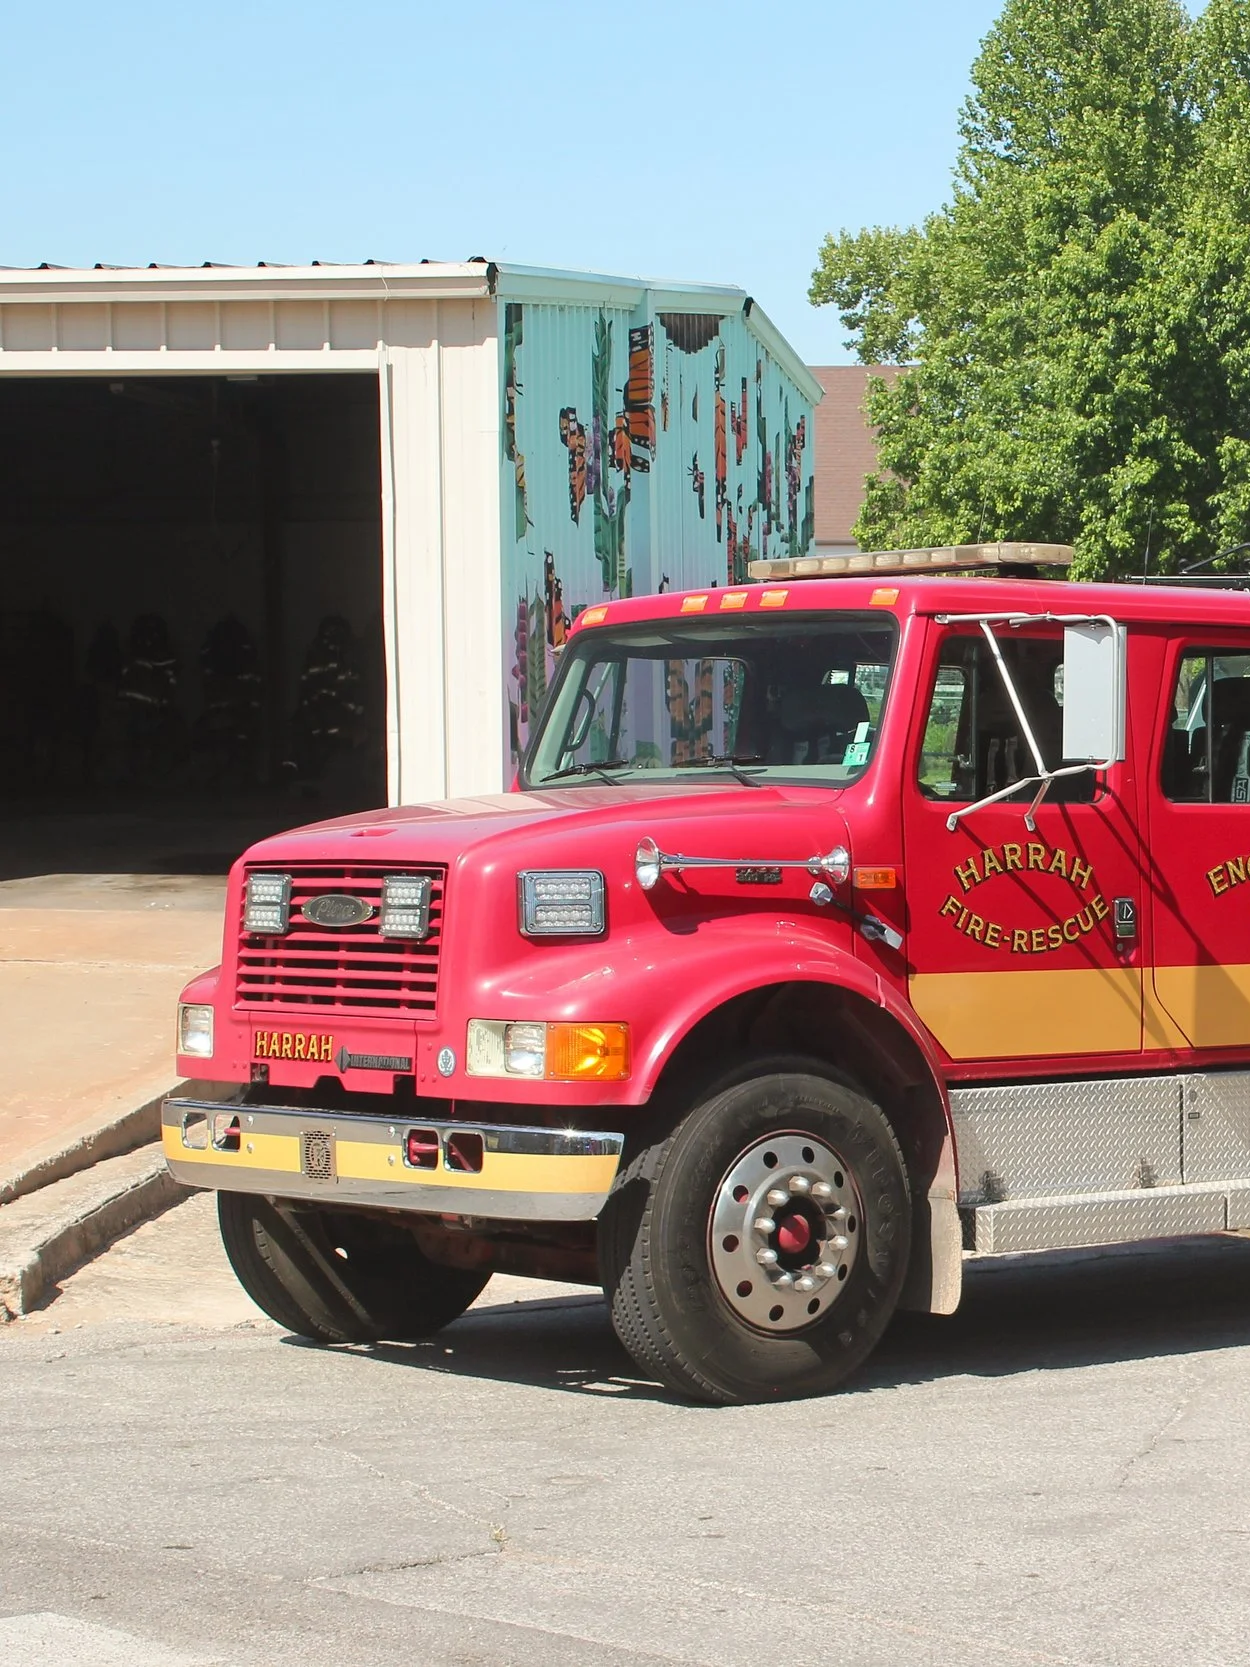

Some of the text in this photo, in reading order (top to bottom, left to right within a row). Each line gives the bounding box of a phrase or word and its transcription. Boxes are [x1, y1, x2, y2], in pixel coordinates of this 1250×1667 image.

[954, 842, 1093, 892] HARRAH
[940, 894, 1110, 953] FIRE-RESCUE
[255, 1030, 334, 1063] HARRAH
[351, 1055, 410, 1070] INTERNATIONAL
